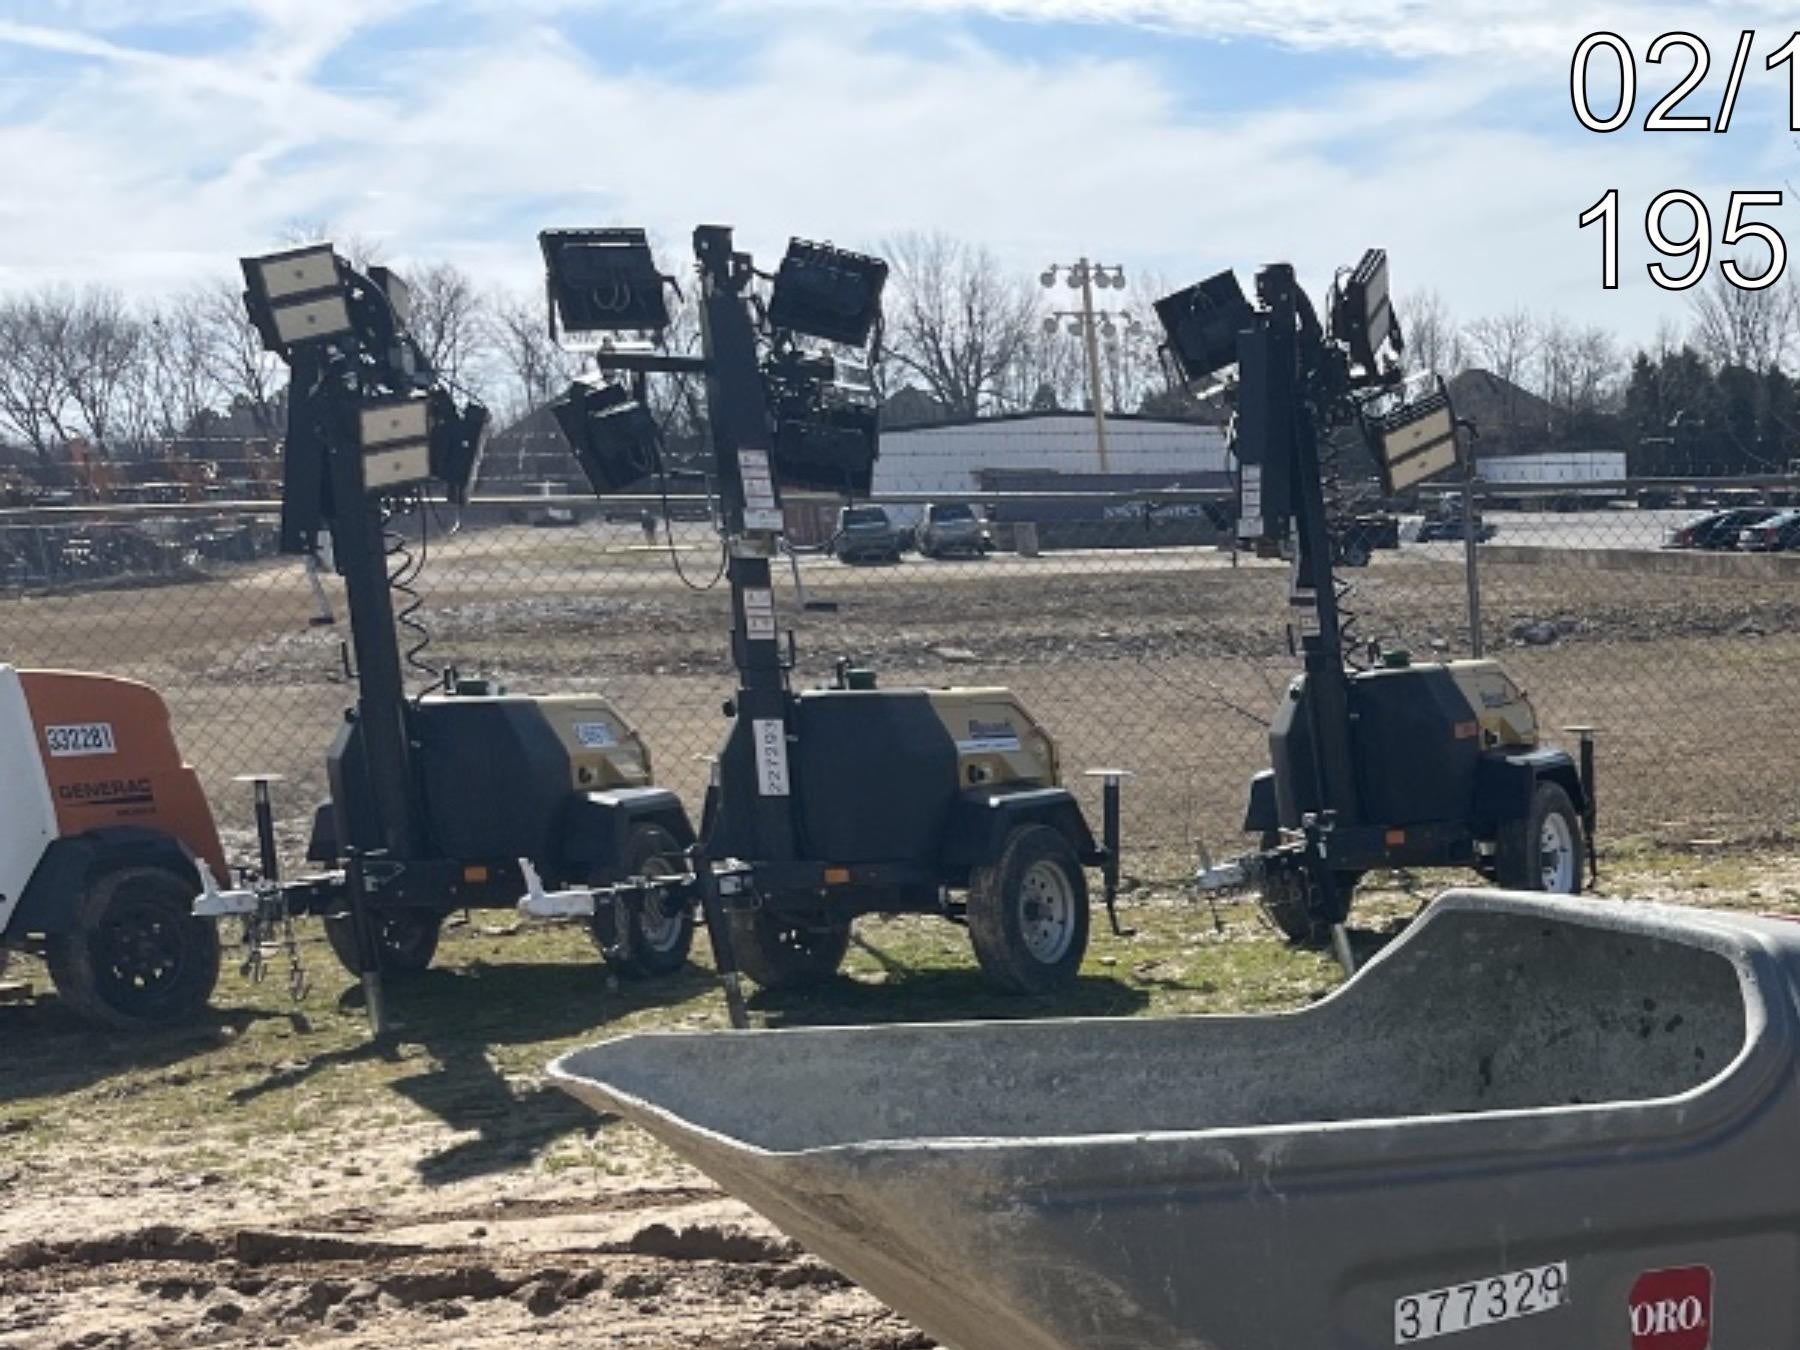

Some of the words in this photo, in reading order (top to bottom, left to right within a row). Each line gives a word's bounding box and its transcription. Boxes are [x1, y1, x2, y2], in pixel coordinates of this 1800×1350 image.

[59, 778, 153, 799] GENERAC
[1399, 1265, 1563, 1340] 377329
[1628, 1295, 1704, 1338] ORO
